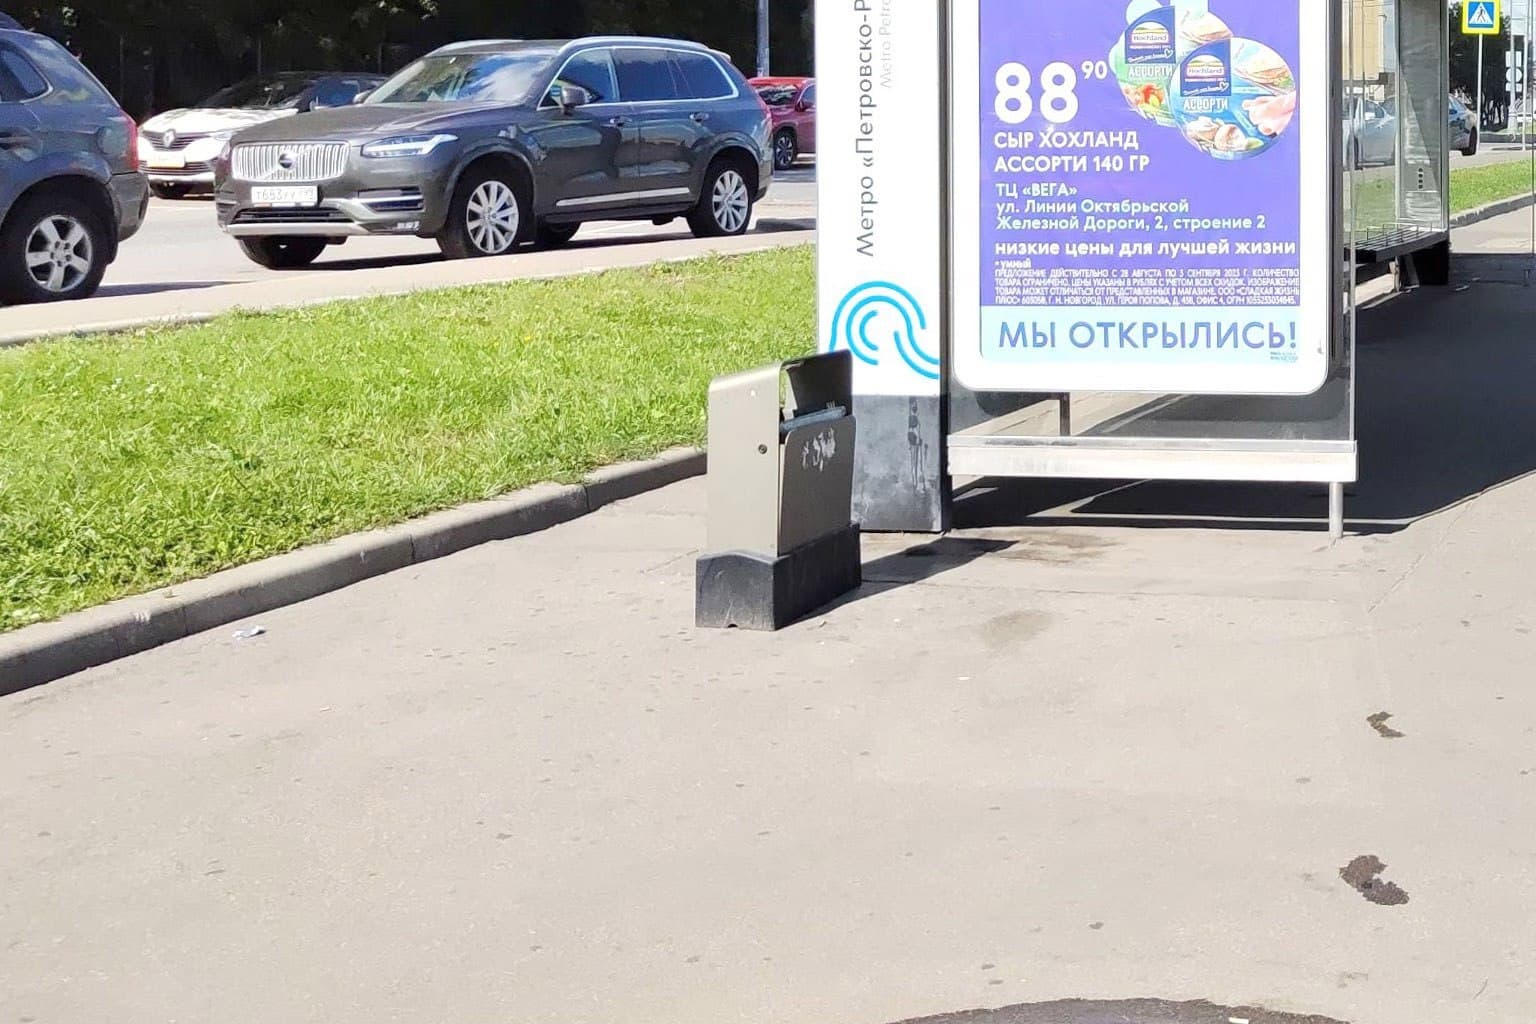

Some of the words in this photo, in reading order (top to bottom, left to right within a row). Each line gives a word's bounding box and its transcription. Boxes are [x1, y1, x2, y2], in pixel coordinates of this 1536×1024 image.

[879, 41, 891, 89] Metro
[994, 61, 1079, 124] 88
[1082, 60, 1108, 80] 90
[1183, 98, 1229, 112] АССОРТИ
[994, 131, 1035, 150] СЫР
[1038, 129, 1139, 151] ХОХЛАНД
[994, 155, 1087, 173] АССОРТИ
[1092, 155, 1123, 172] 140
[1129, 155, 1150, 172] ГР
[996, 182, 1018, 199] ТЦ
[1022, 182, 1077, 197] «ВЕГА»
[856, 176, 878, 257] Метро
[996, 201, 1020, 216] ул.
[1024, 199, 1077, 214] Линии
[1081, 198, 1189, 216] Октябрьской
[996, 214, 1079, 230] Железной
[1083, 215, 1150, 232] Дороги,
[1155, 215, 1168, 231] 2,
[1173, 216, 1252, 231] строение
[1257, 215, 1266, 229] 2
[995, 241, 1060, 255] низкие
[1065, 241, 1114, 258] цены
[1119, 240, 1153, 257] для
[1157, 238, 1229, 258] лучшей
[1233, 240, 1296, 255] жизни
[998, 321, 1056, 349] МЫ
[1068, 320, 1297, 349] ОТКРЫЛИСЬ!
